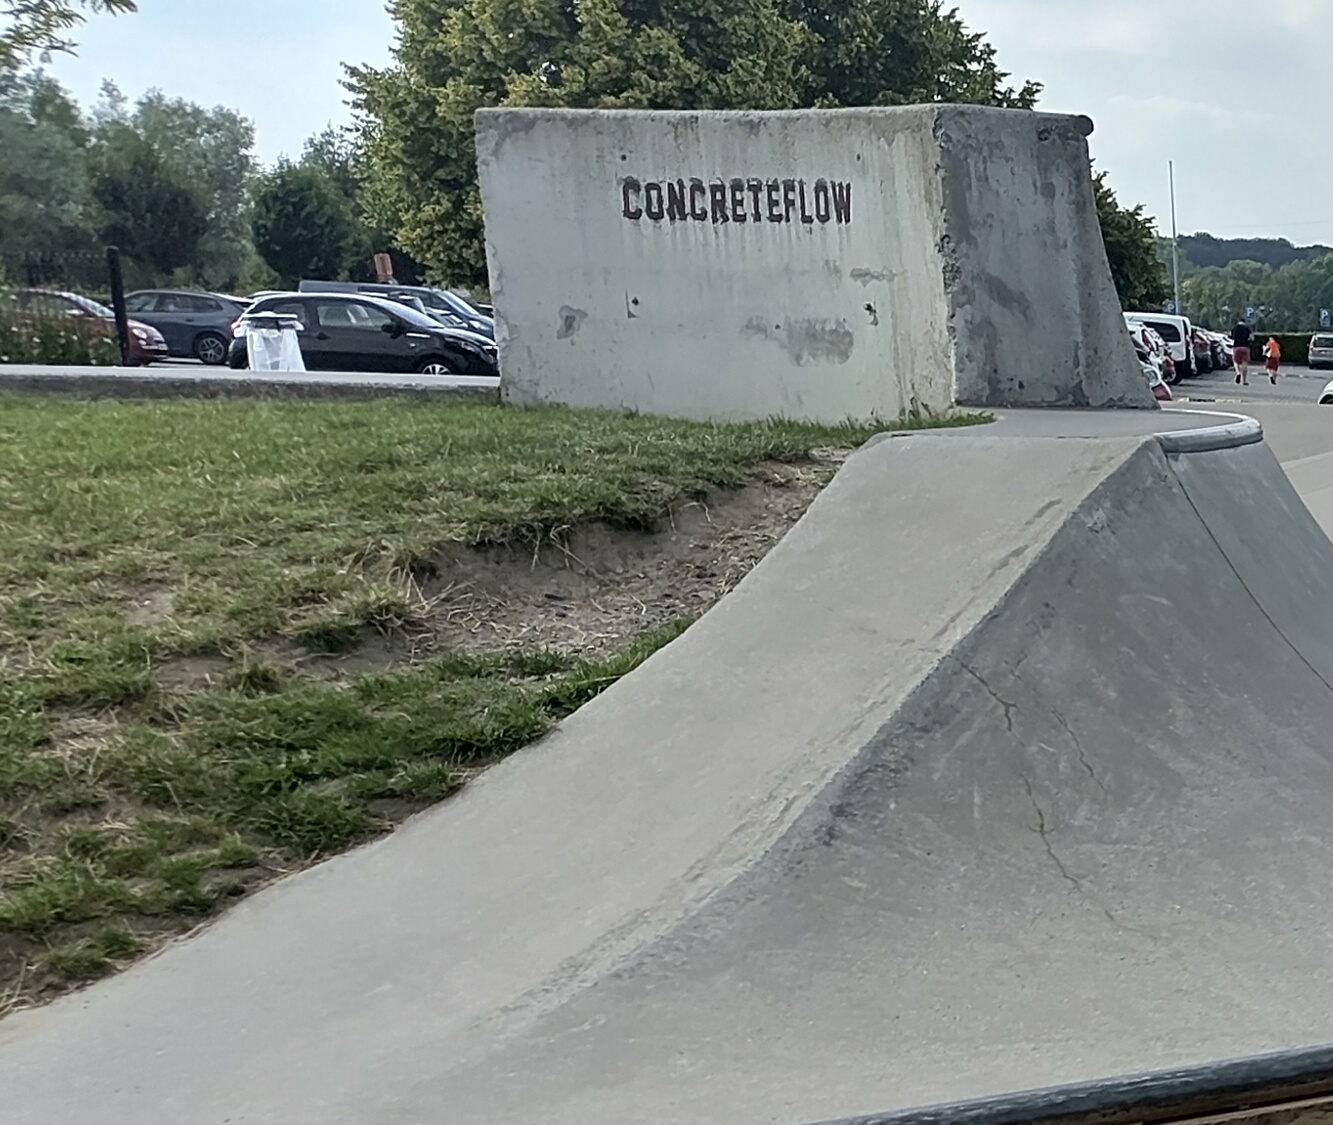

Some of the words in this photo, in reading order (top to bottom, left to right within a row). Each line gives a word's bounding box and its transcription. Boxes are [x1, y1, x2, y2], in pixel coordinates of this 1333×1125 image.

[621, 175, 851, 225] CONCRETEFLOW
[1247, 307, 1254, 317] P
[1321, 310, 1329, 320] P
